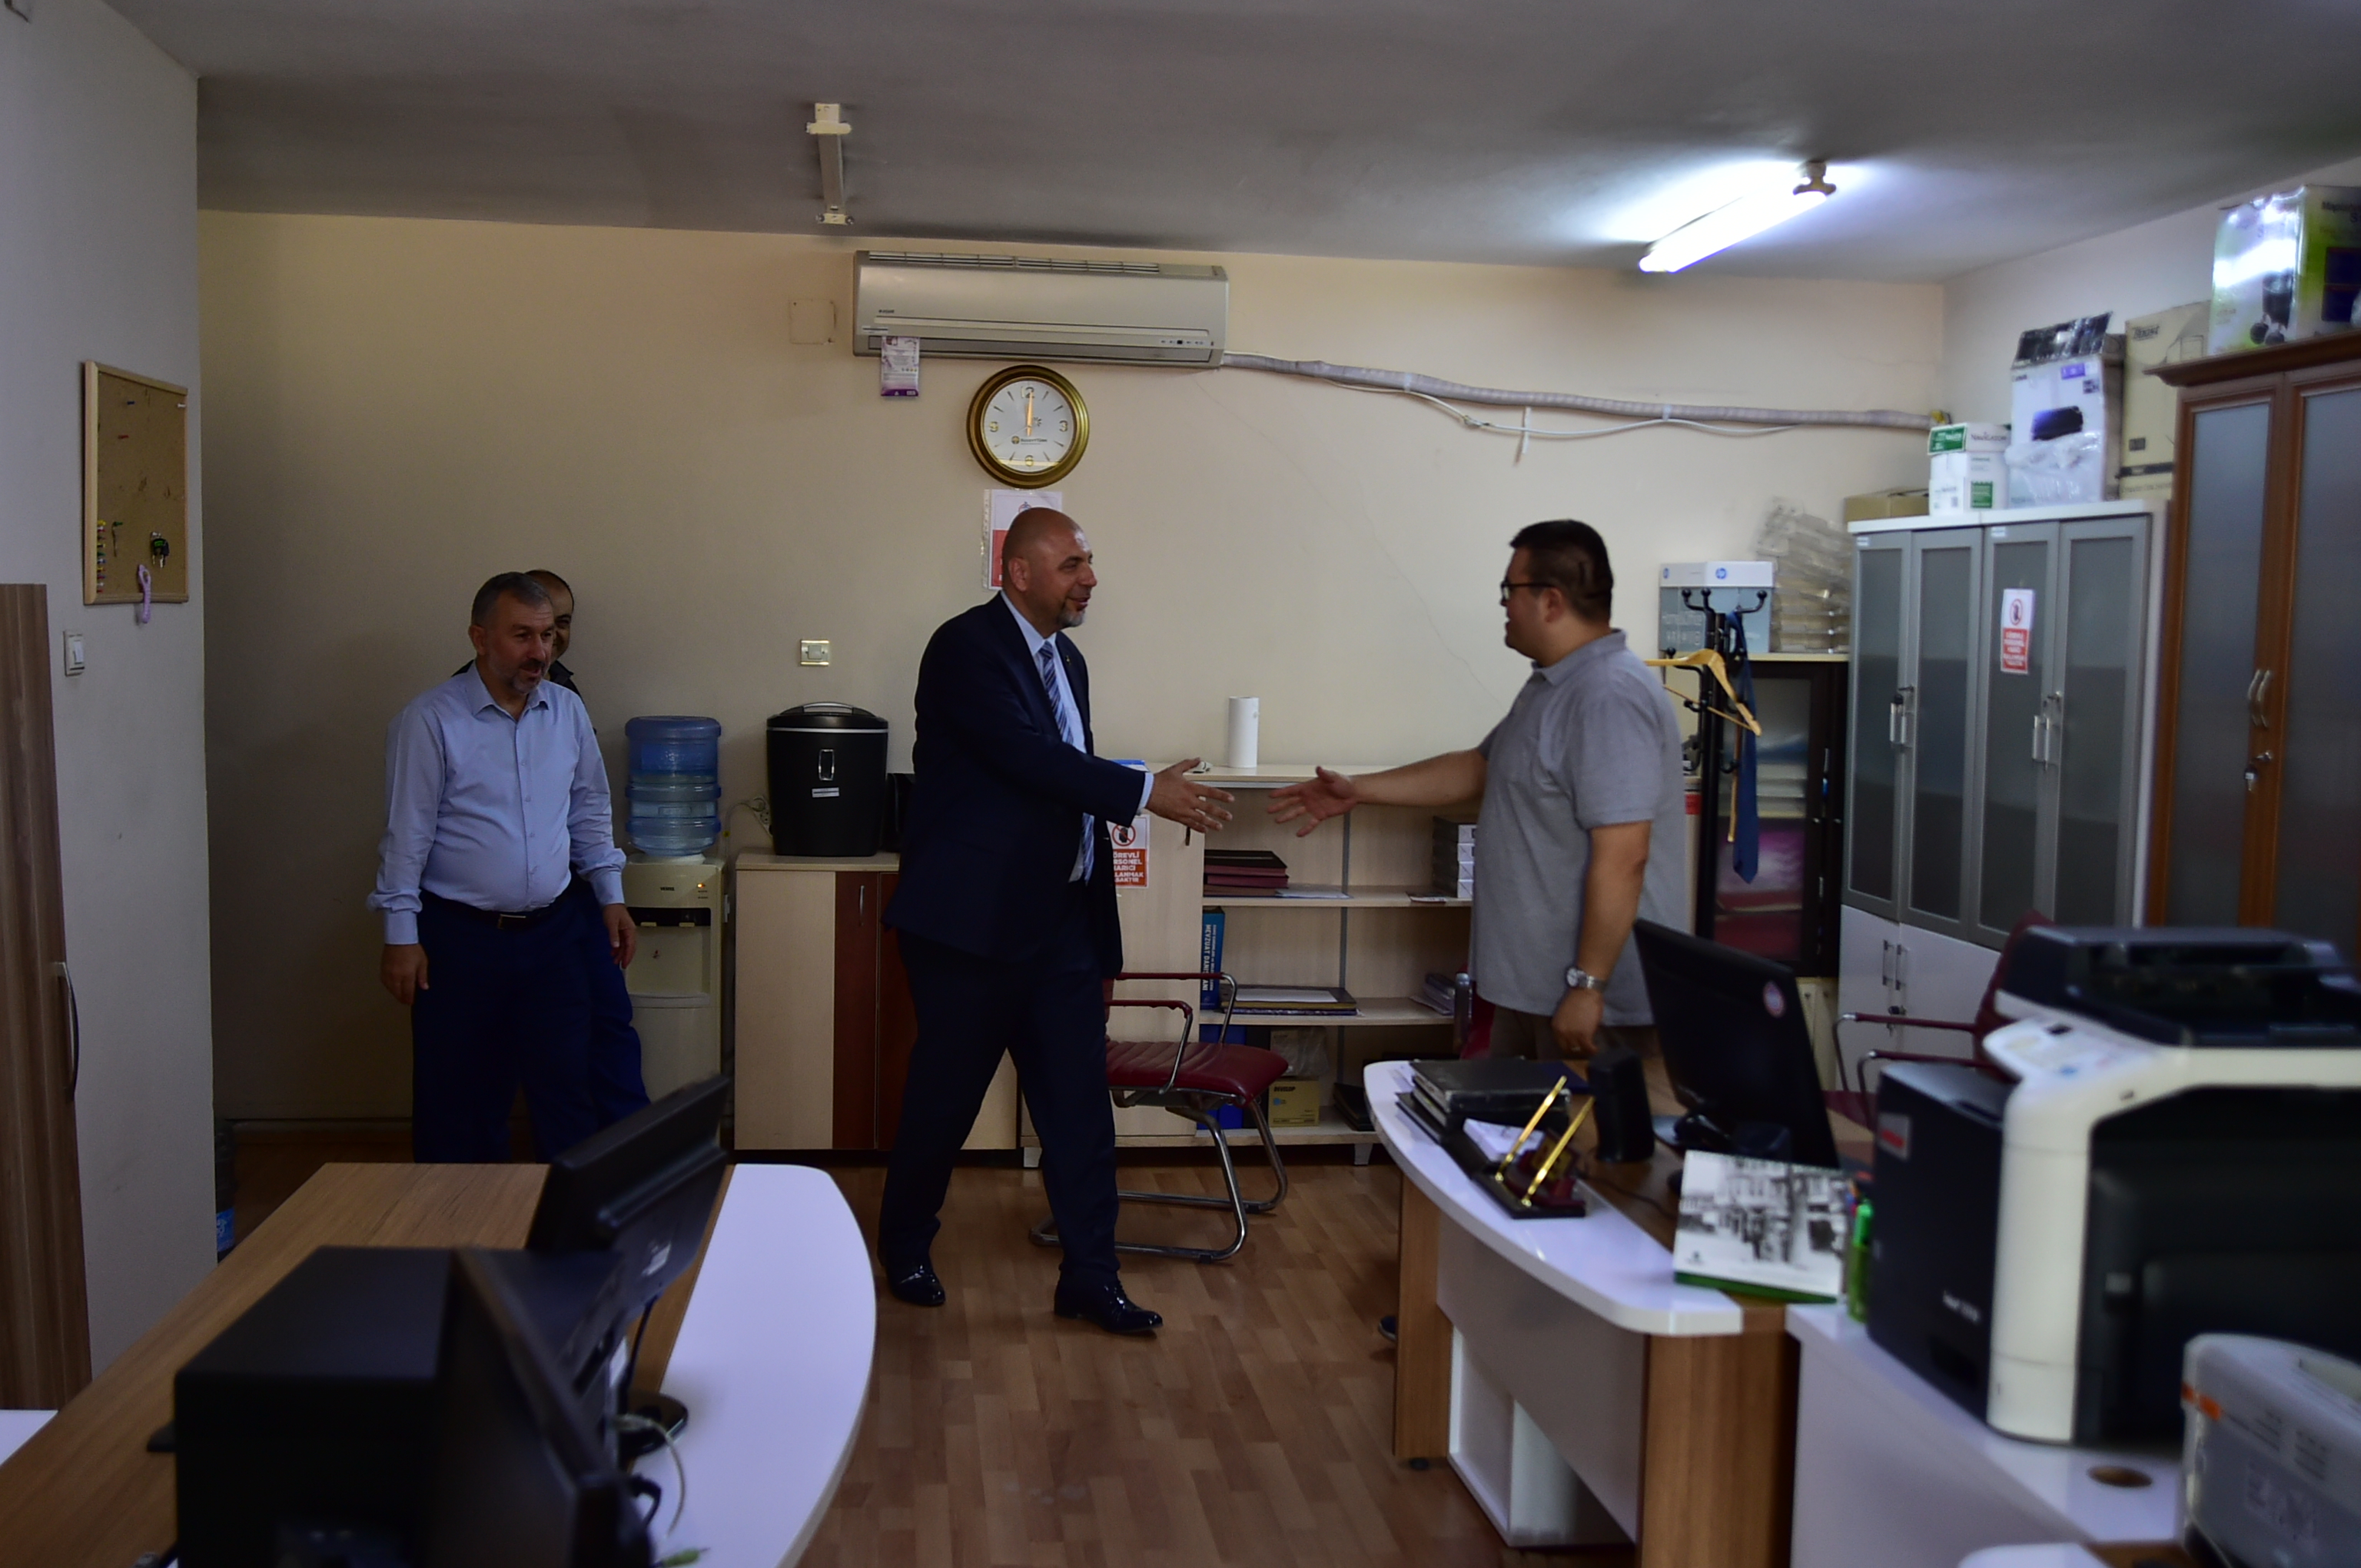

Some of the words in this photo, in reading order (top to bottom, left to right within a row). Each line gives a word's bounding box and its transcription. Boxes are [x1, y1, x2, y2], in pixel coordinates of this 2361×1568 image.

[1059, 420, 1068, 433] 3
[1024, 454, 1034, 467] 6
[1202, 955, 1210, 991] DANIŞANI
